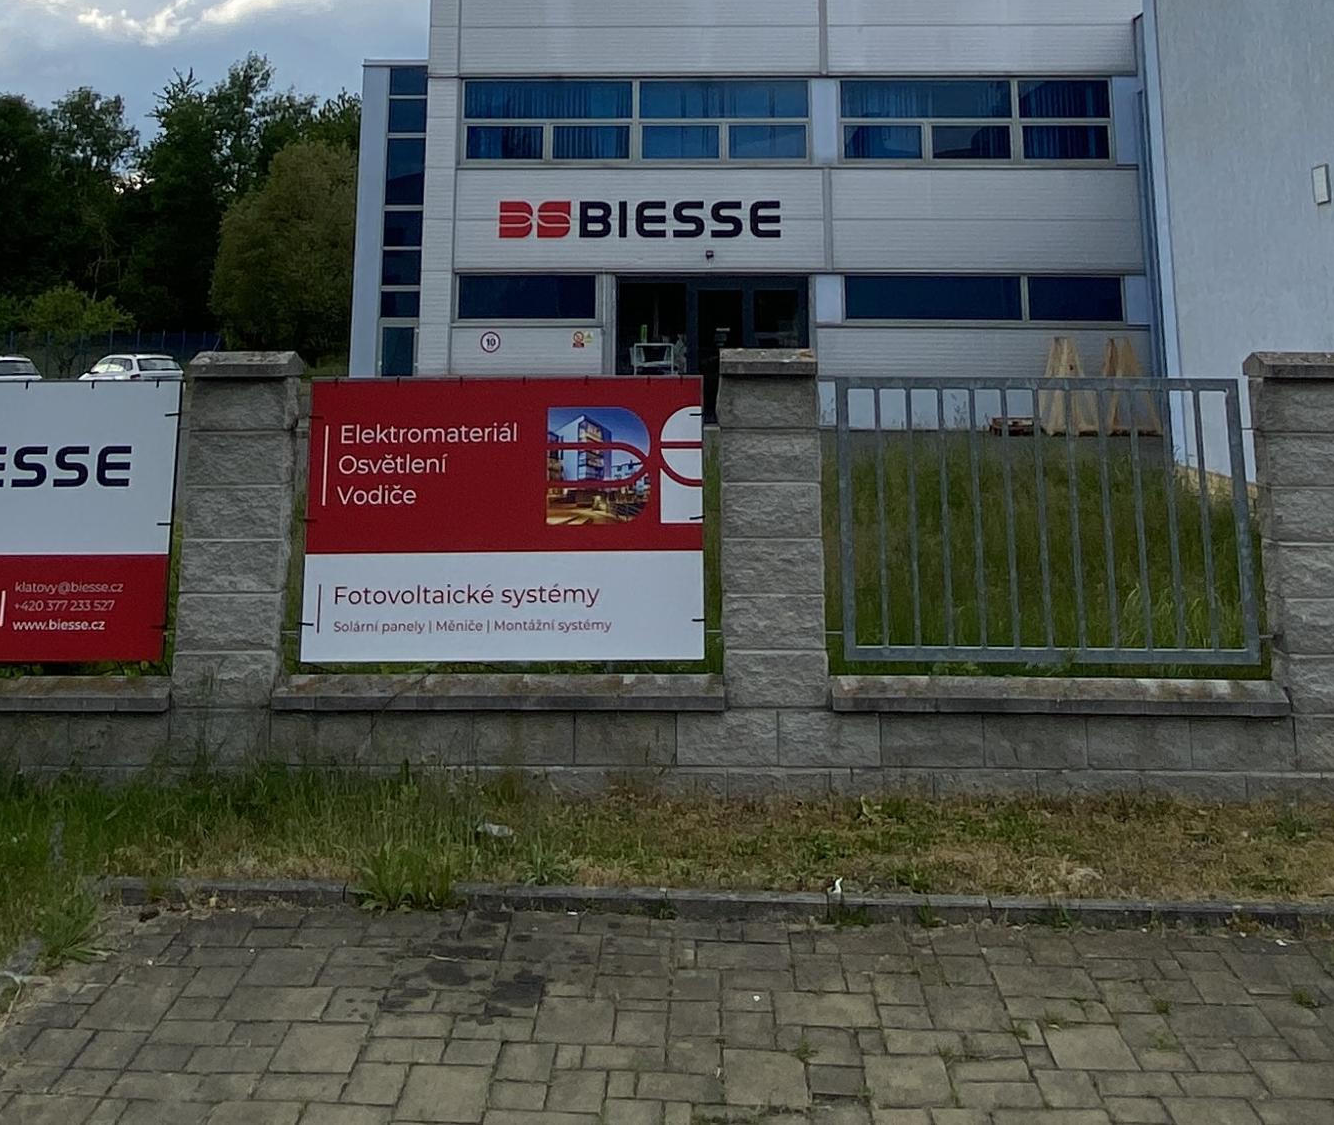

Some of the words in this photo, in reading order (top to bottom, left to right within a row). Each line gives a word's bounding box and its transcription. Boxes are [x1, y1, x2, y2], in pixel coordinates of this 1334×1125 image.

[579, 201, 781, 238] BIESSE
[341, 422, 518, 444] Elektromateriál
[338, 453, 448, 475] Osvětlení
[337, 484, 417, 505] Vodiče
[14, 581, 124, 595] klatovy@biesse.cz
[334, 583, 494, 605] Fotovoltaické
[501, 583, 600, 608] systémy
[14, 599, 44, 612] +420
[46, 599, 68, 612] 377
[69, 599, 91, 612] 233
[92, 599, 115, 612] 527
[12, 618, 106, 631] www.biesse.cz
[333, 619, 379, 633] Solární
[381, 620, 426, 635] panely
[435, 619, 483, 632] Měniče
[494, 619, 555, 632] Montážní
[557, 619, 612, 633] systémy
